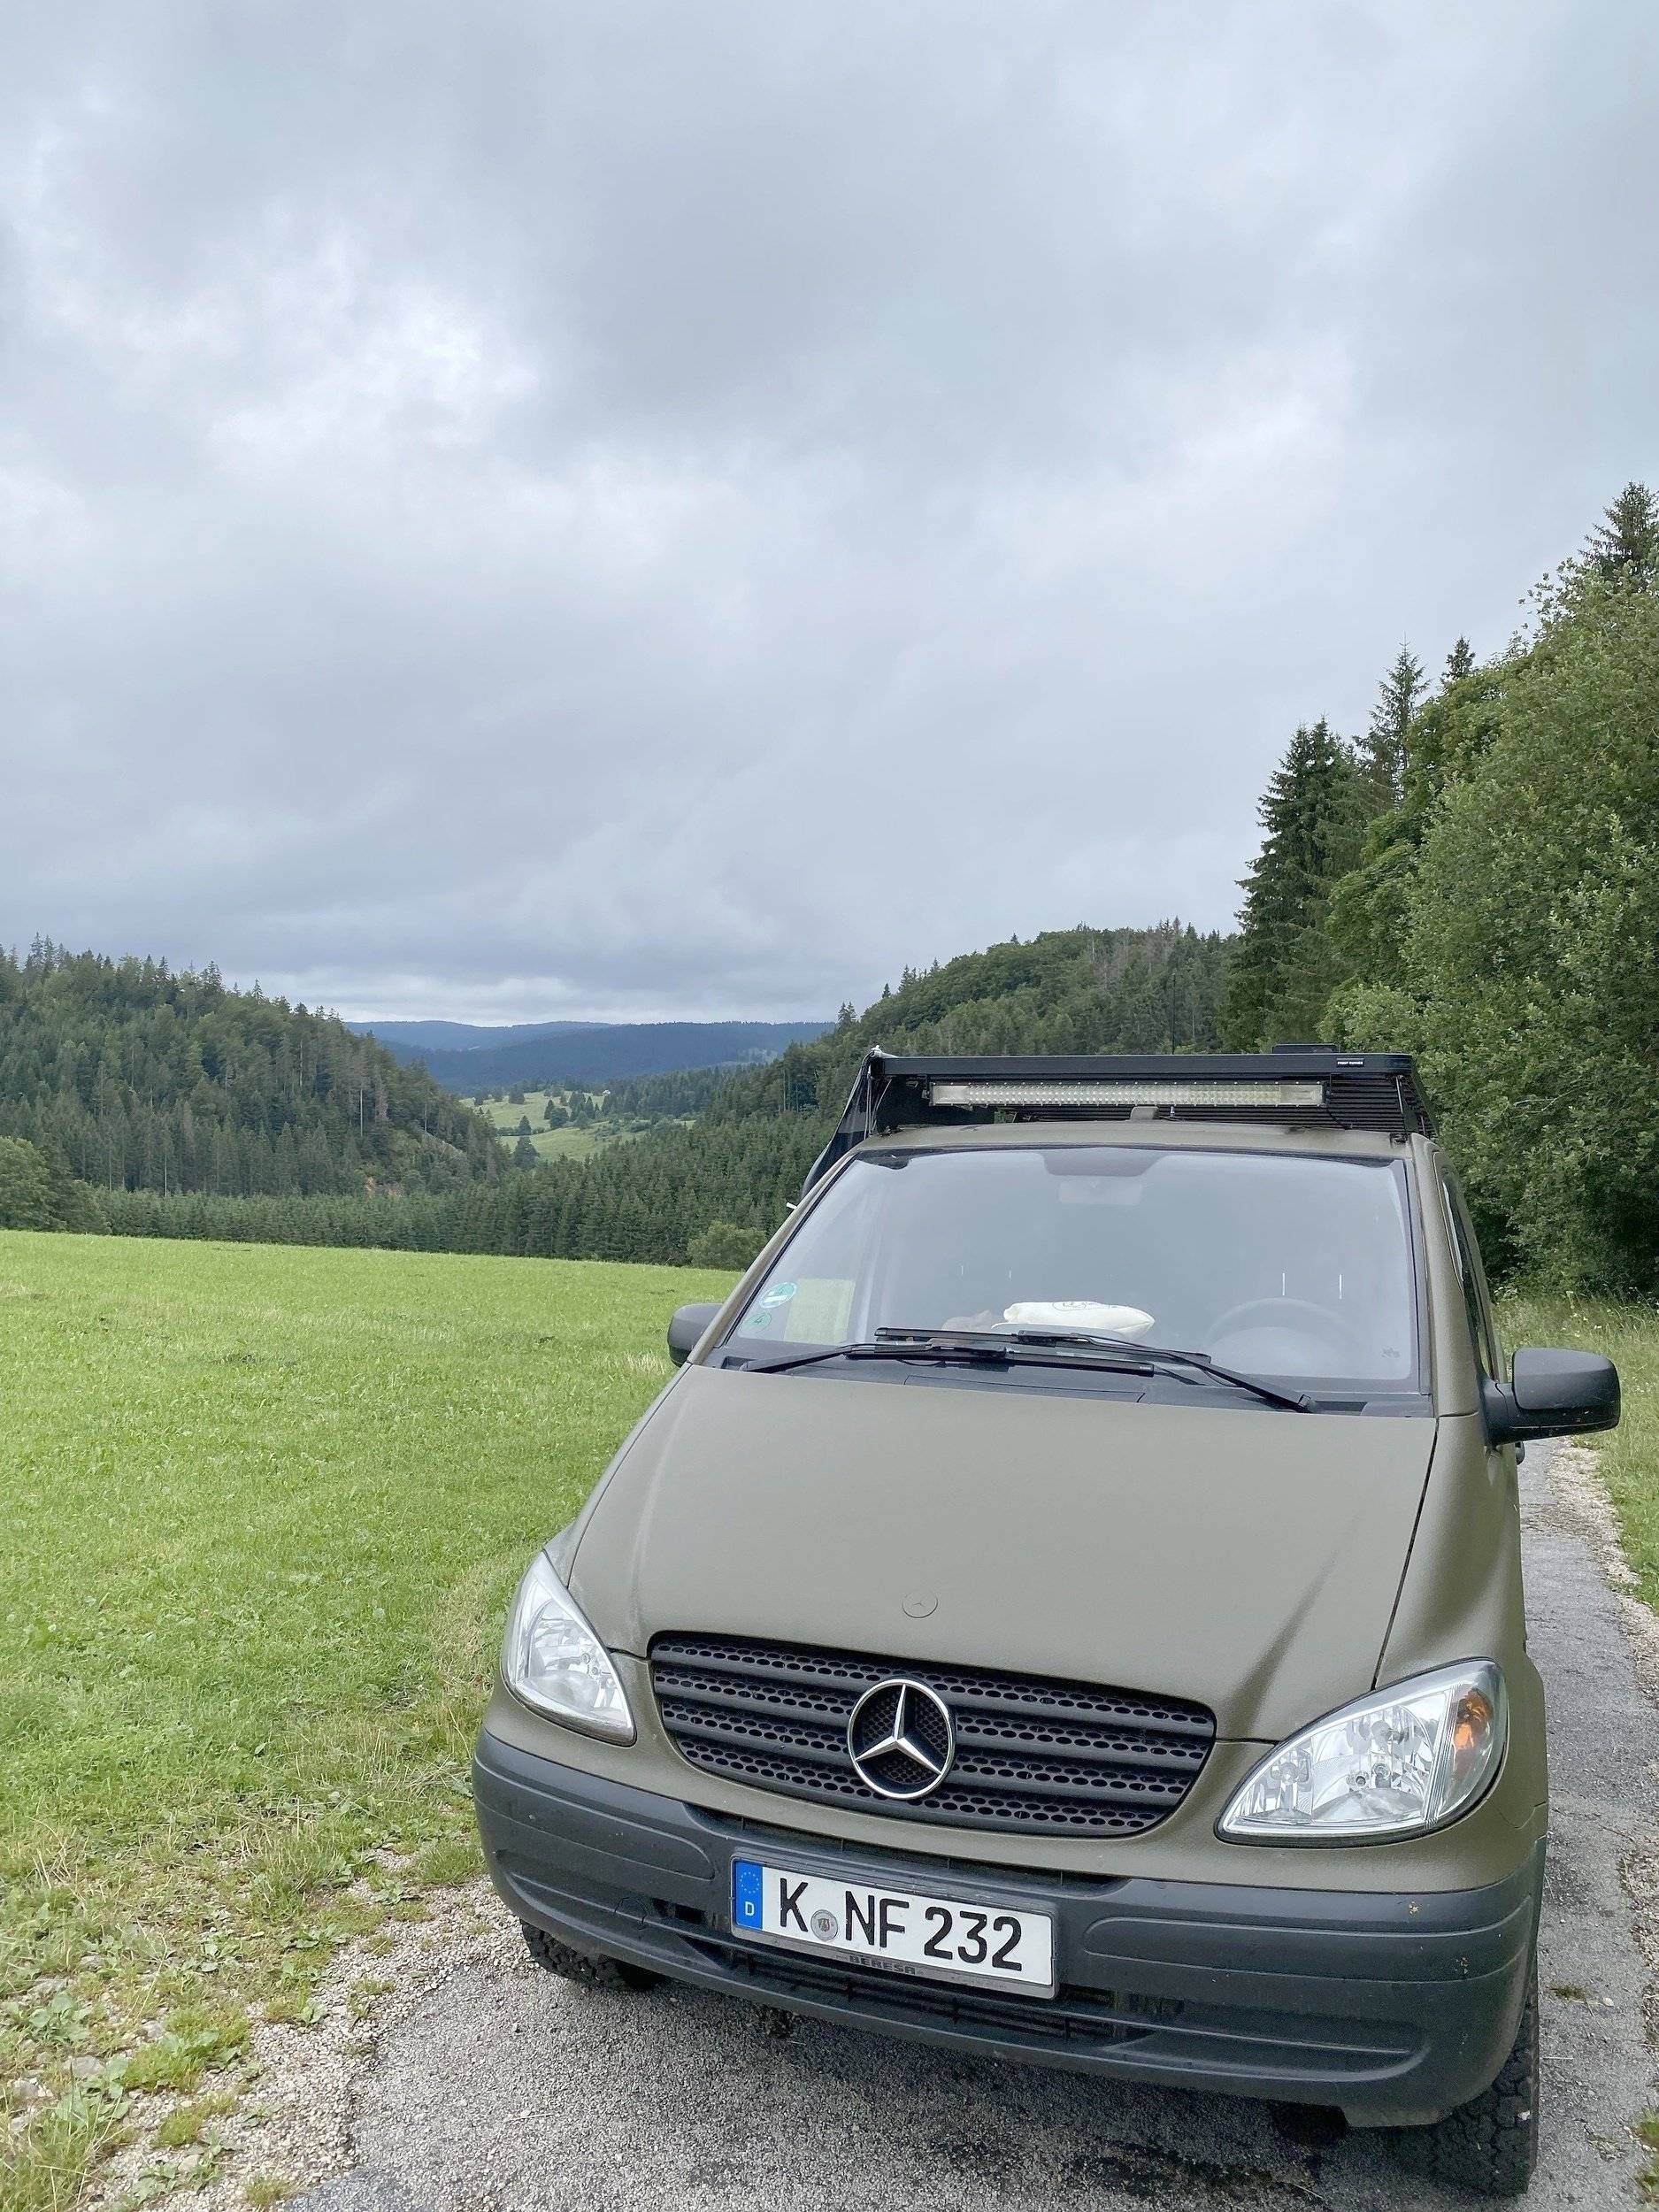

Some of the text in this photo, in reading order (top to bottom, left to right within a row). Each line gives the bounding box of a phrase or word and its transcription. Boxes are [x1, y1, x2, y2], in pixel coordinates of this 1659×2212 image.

[745, 1901, 755, 1916] D
[780, 1878, 1023, 1971] K NF 232
[849, 1955, 916, 1975] BERESA
